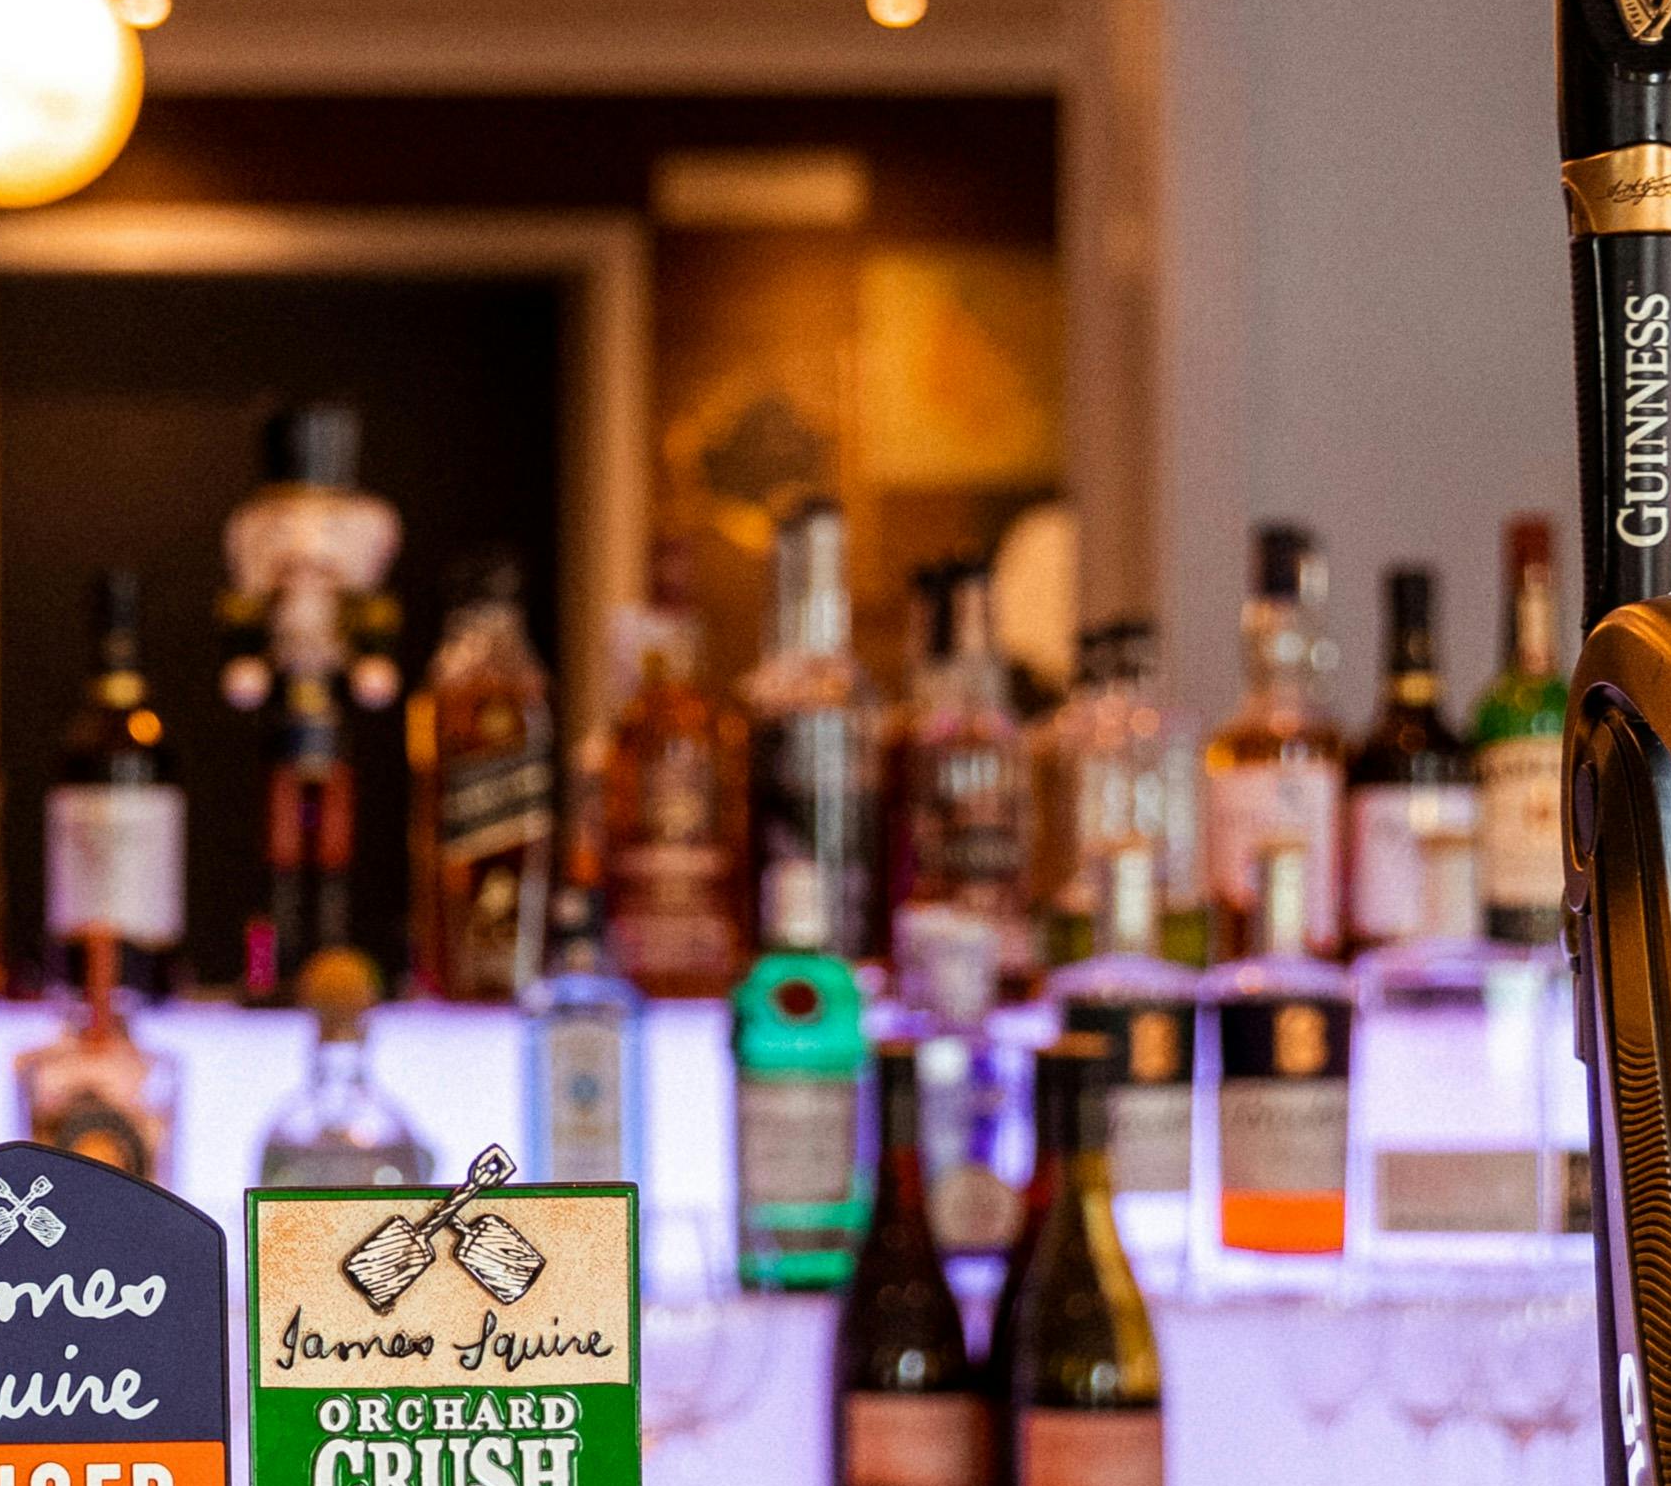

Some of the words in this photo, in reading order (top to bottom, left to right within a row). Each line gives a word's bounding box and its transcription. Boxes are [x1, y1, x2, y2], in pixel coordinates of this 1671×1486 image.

[1616, 293, 1670, 547] GUINNESS
[276, 1305, 433, 1370] James
[453, 1310, 614, 1371] Squire
[319, 1397, 575, 1432] ORCHARD
